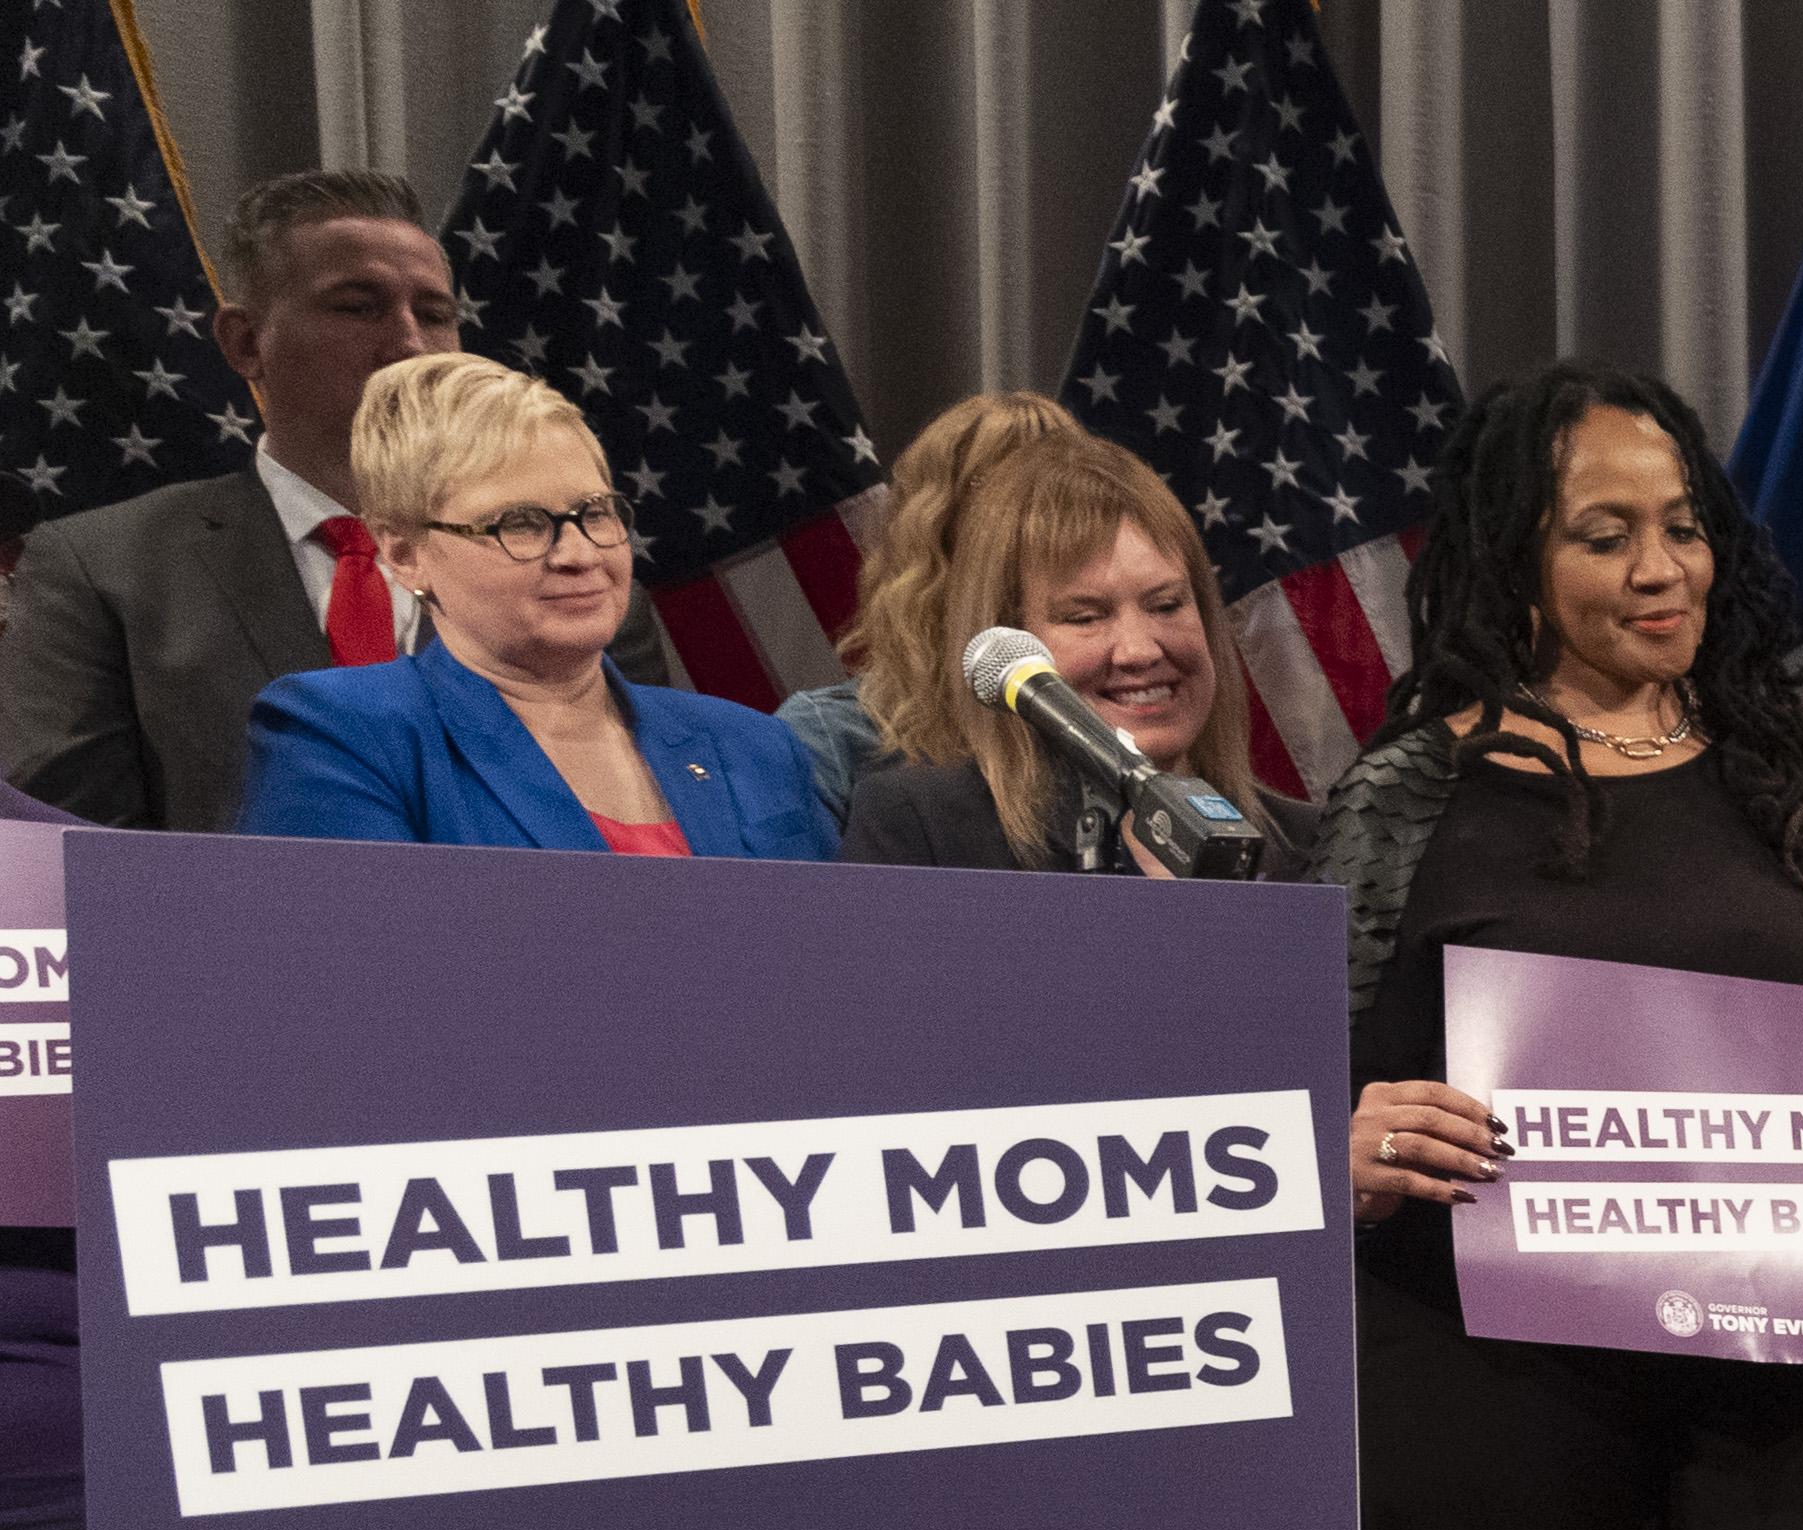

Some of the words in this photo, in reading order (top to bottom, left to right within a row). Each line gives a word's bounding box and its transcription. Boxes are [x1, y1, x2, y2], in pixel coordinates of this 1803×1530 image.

[1515, 1107, 1770, 1149] HEALTHY
[169, 1153, 835, 1283] HEALTHY
[882, 1126, 1278, 1233] MOMS
[1526, 1198, 1753, 1234] HEALTHY
[1708, 1303, 1767, 1315] GOVERNOR
[1708, 1314, 1769, 1333] TONY
[202, 1349, 792, 1473] HEALTHY
[835, 1312, 1260, 1419] BABIES
